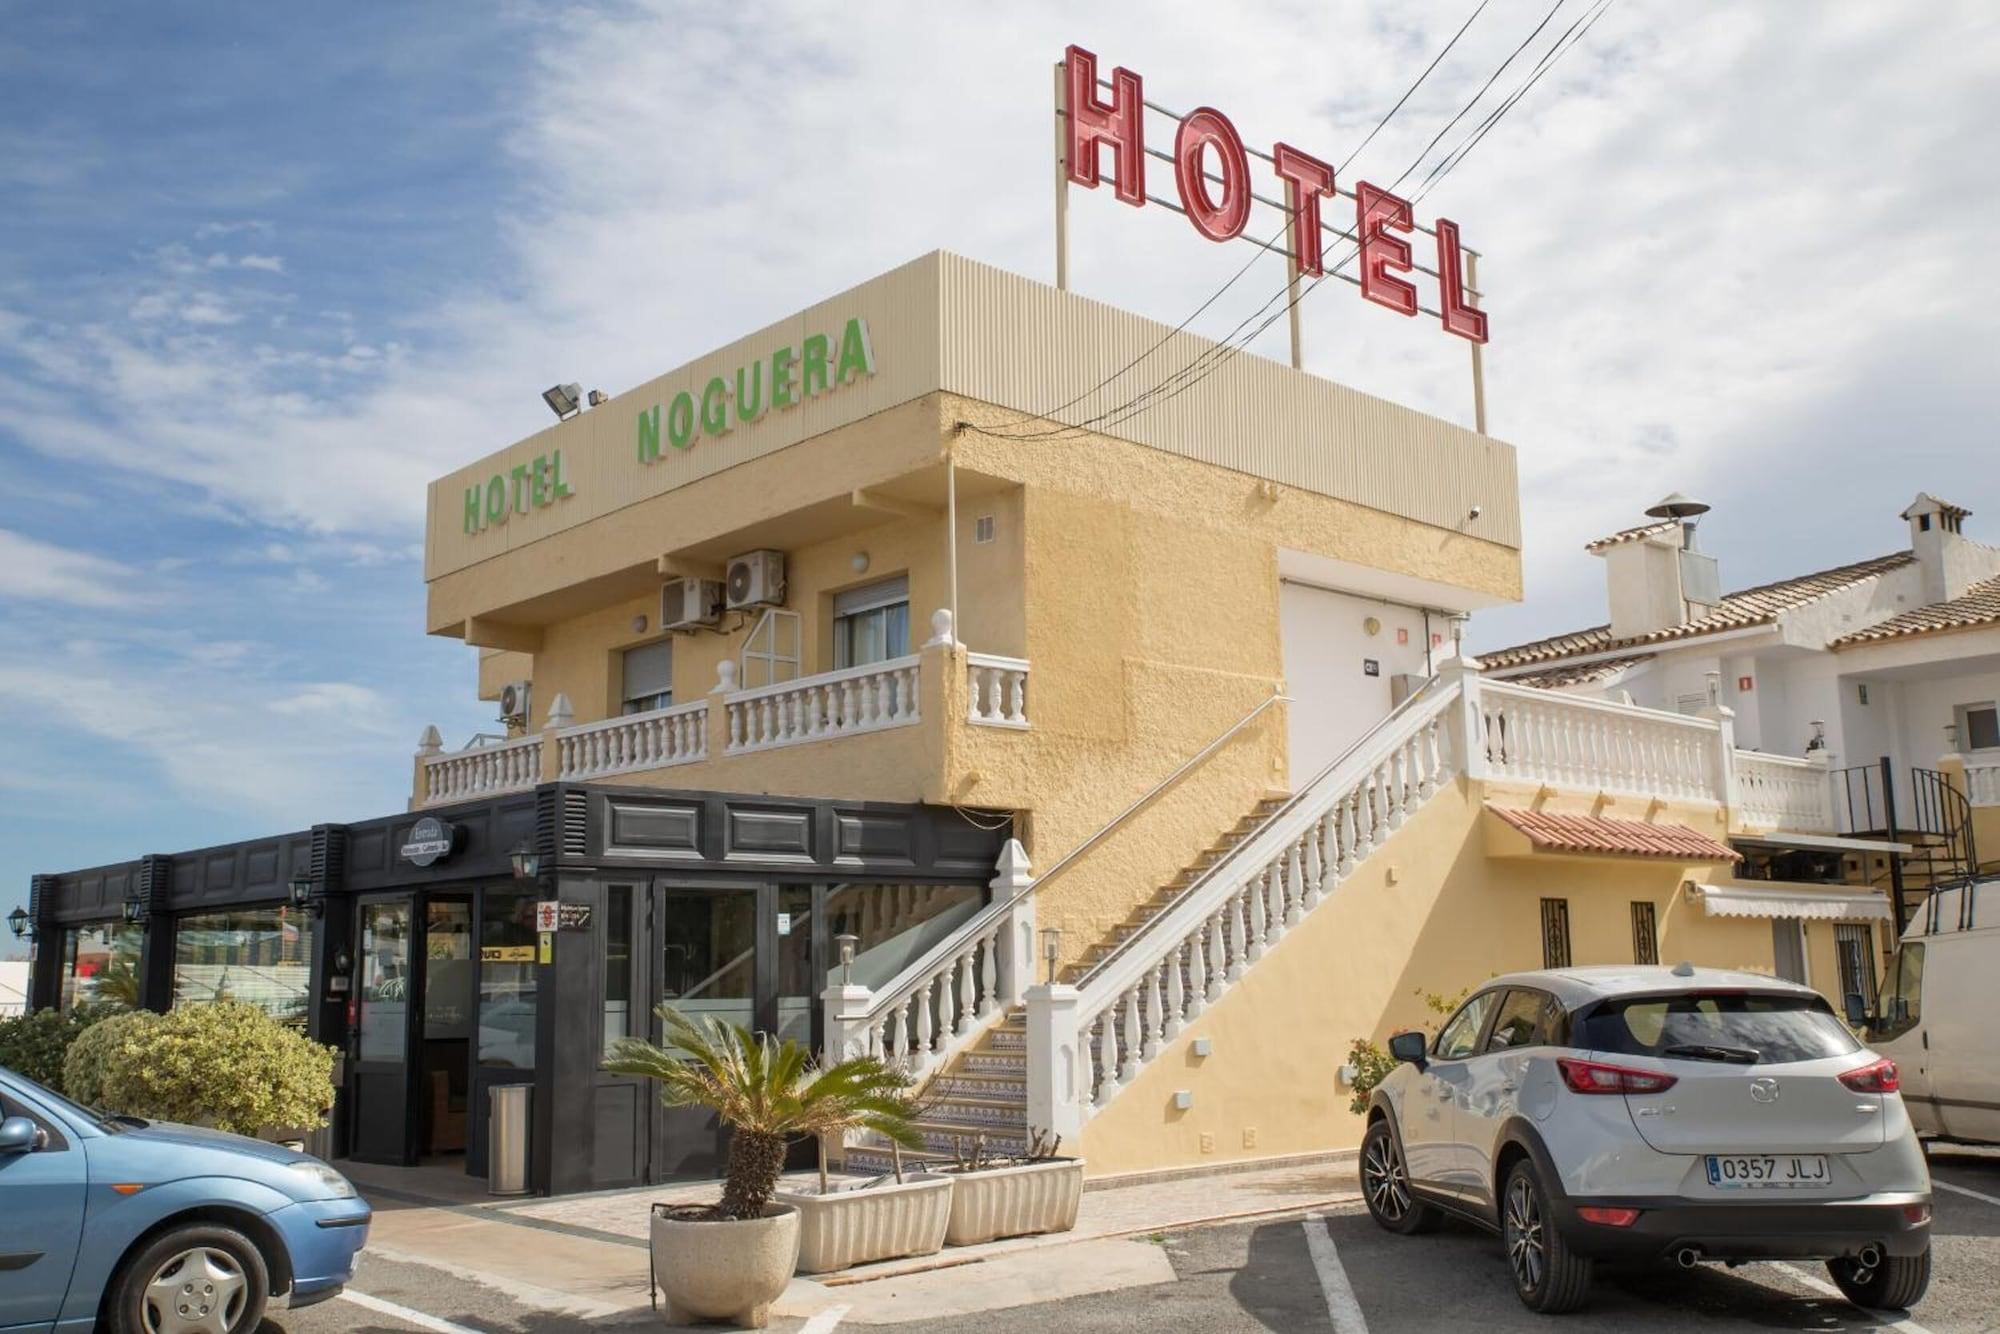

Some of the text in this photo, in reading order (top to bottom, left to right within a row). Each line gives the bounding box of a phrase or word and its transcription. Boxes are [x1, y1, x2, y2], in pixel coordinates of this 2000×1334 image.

[1065, 44, 1489, 344] HOTEL
[463, 317, 875, 535] HOTEL NOGUERA
[1722, 1158, 1824, 1180] 0357 JLJ
